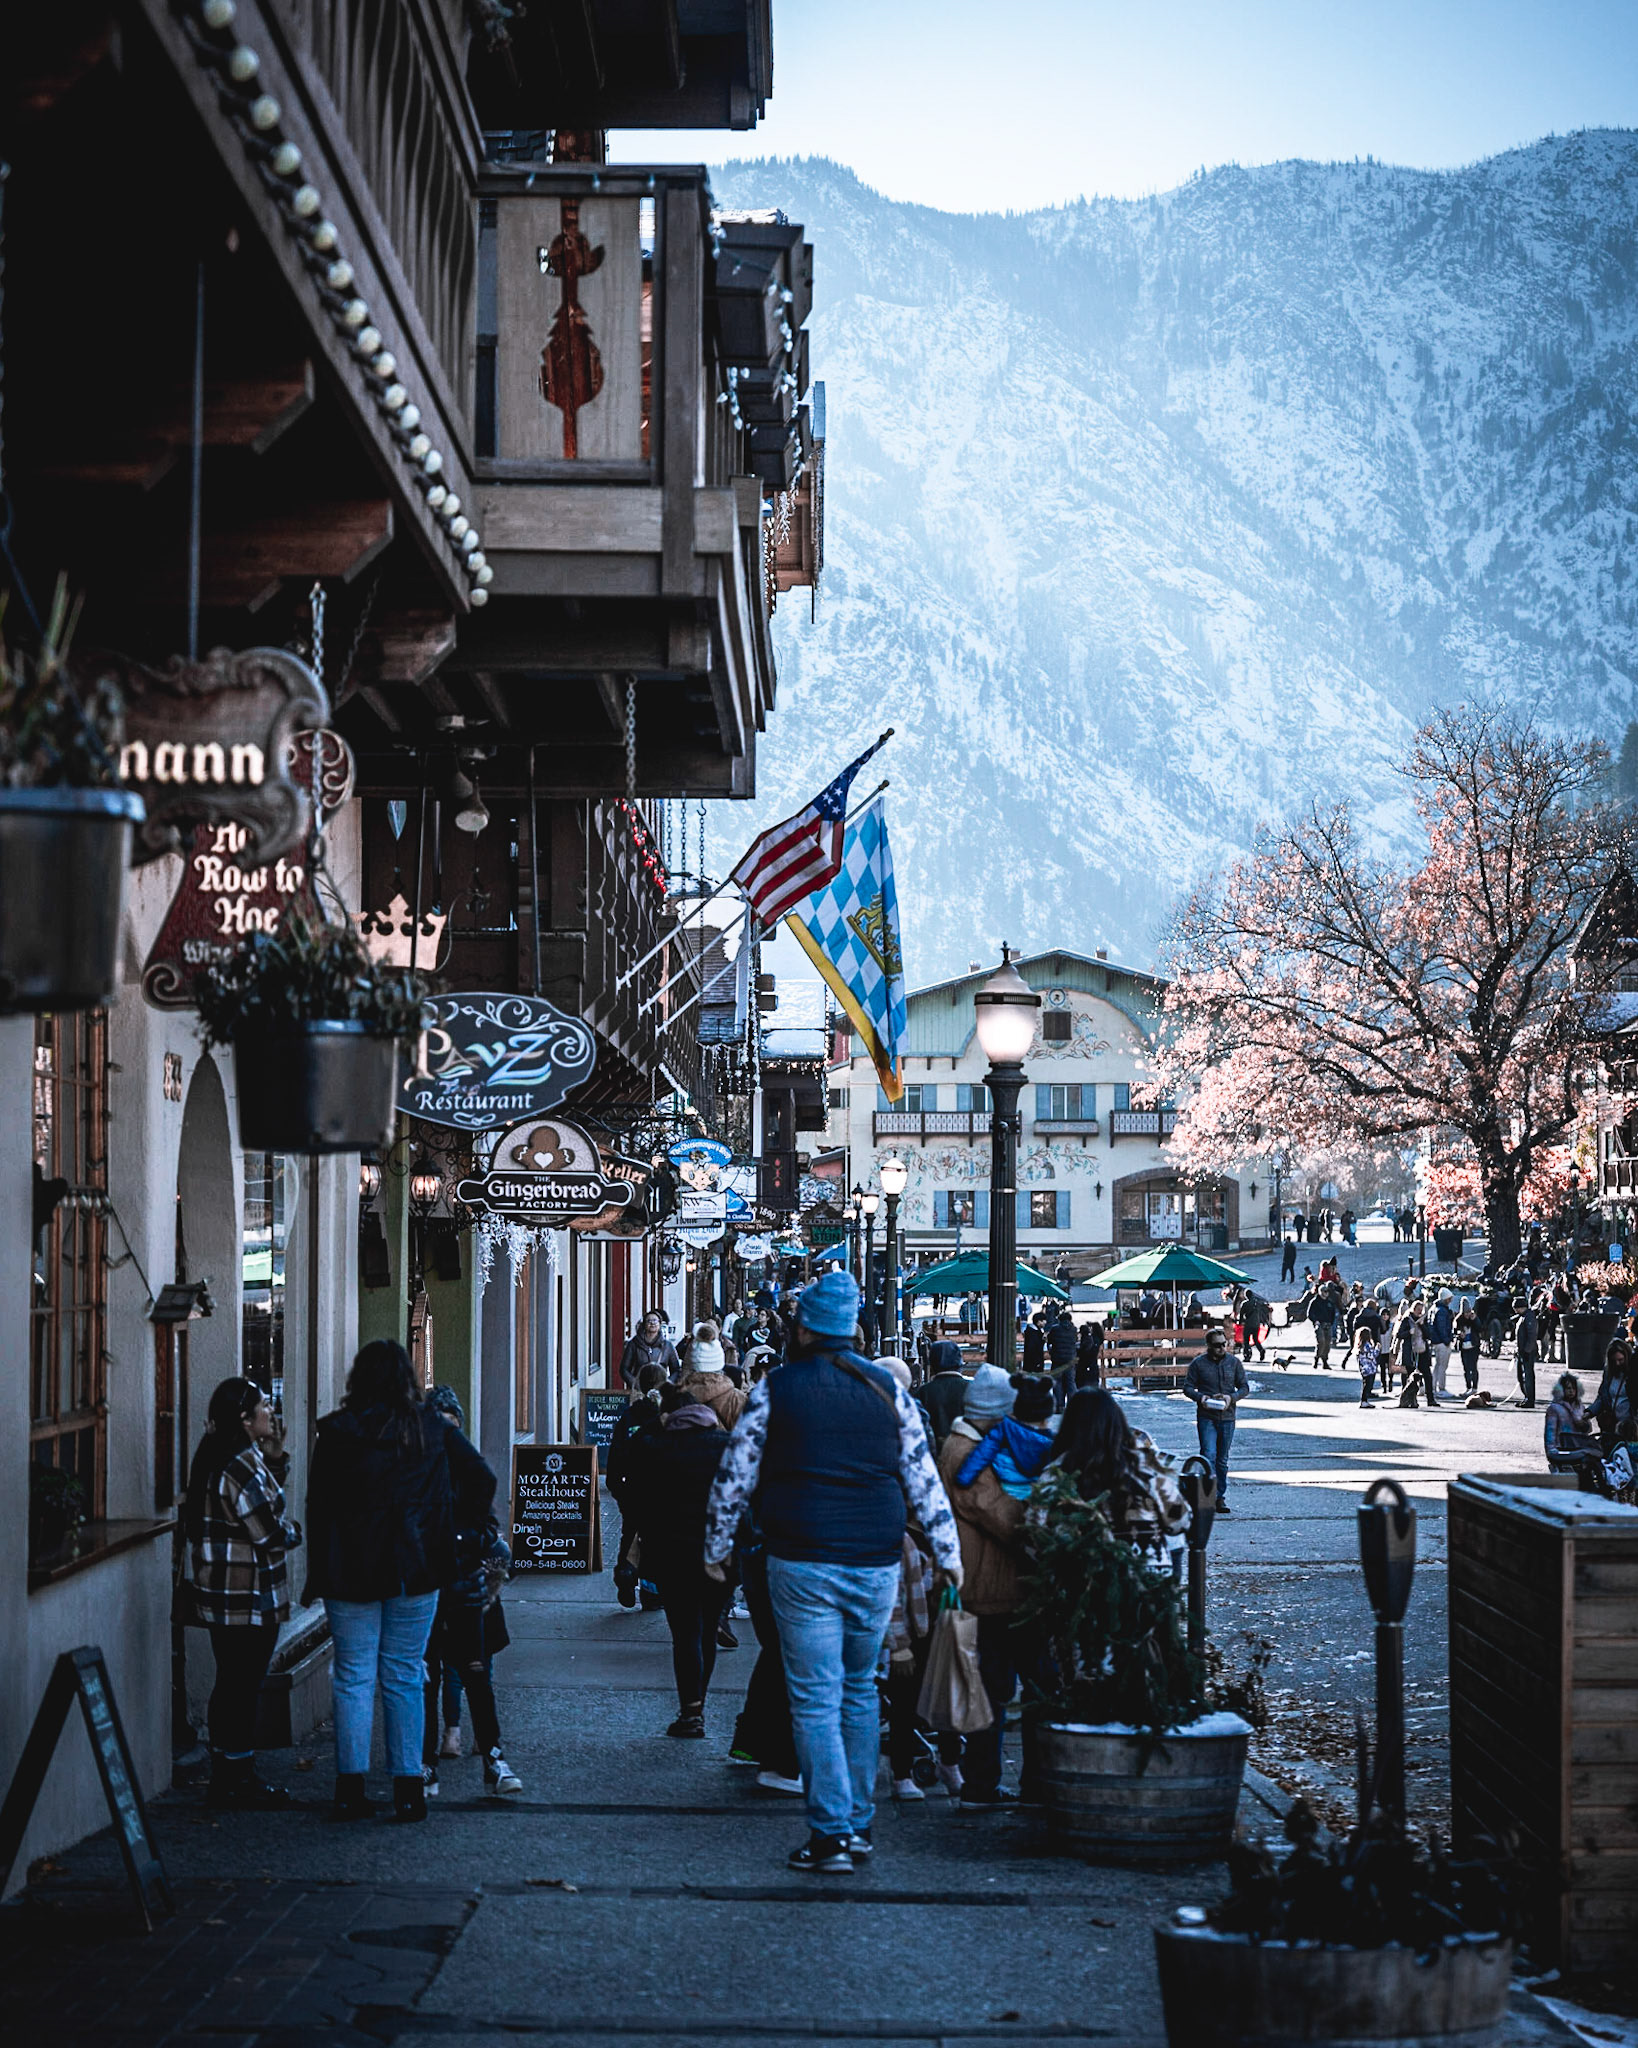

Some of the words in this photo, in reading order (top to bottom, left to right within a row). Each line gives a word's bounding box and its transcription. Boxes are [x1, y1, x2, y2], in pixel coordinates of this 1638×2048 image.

[194, 854, 268, 893] Row
[214, 894, 280, 935] Hoe
[415, 1090, 534, 1110] Restaurant
[487, 1180, 601, 1200] Gingerbread
[759, 1205, 777, 1221] 1890
[588, 1411, 622, 1422] Welcom
[548, 1459, 559, 1468] M
[517, 1474, 591, 1485] MOZART'S
[519, 1485, 587, 1498] Steakhouse
[525, 1500, 555, 1510] Delicious
[556, 1500, 580, 1510] Steaks
[522, 1511, 551, 1521] Amazing
[551, 1511, 582, 1520] Cocktails
[526, 1535, 576, 1550] Open
[514, 1559, 586, 1569] 509-548-0600
